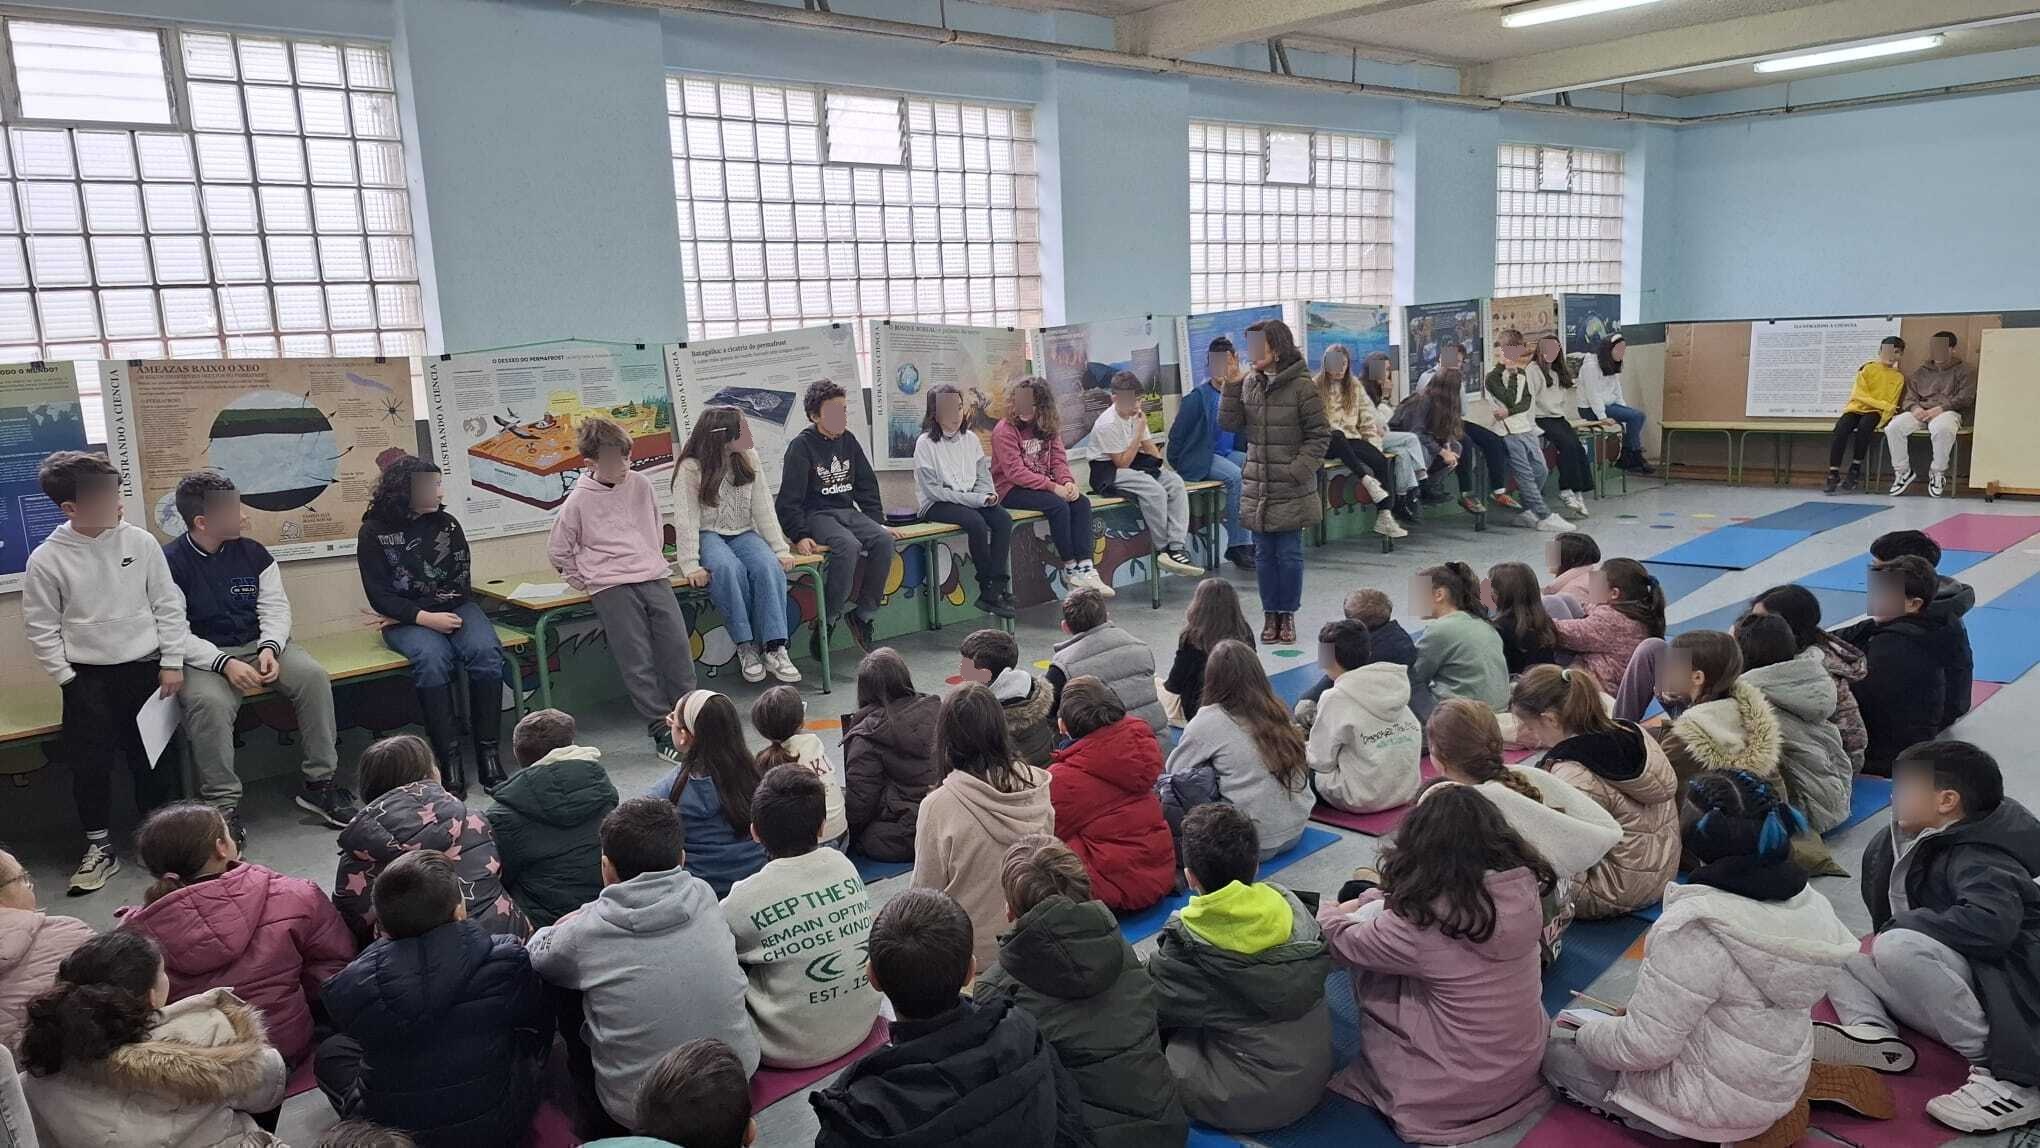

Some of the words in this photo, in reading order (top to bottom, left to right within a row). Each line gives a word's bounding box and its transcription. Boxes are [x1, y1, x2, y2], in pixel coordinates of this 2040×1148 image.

[0, 368, 17, 376] ODO
[136, 364, 190, 375] AMEAZAS
[192, 363, 226, 374] BAIXO
[228, 363, 236, 373] O
[238, 362, 261, 373] XEO
[430, 363, 442, 404] CIENCIA
[672, 351, 684, 387] CIENCIA
[108, 369, 124, 415] CIENCIA
[114, 416, 125, 425] A
[116, 426, 133, 497] ILUSTRANDO
[436, 414, 452, 475] ILUSTRANDO
[821, 483, 853, 496] adidas
[750, 896, 800, 931] KEEP
[801, 883, 846, 909] THE
[760, 916, 824, 950] REMAIN
[828, 900, 872, 924] OPTIM
[763, 930, 836, 963] CHOOSE
